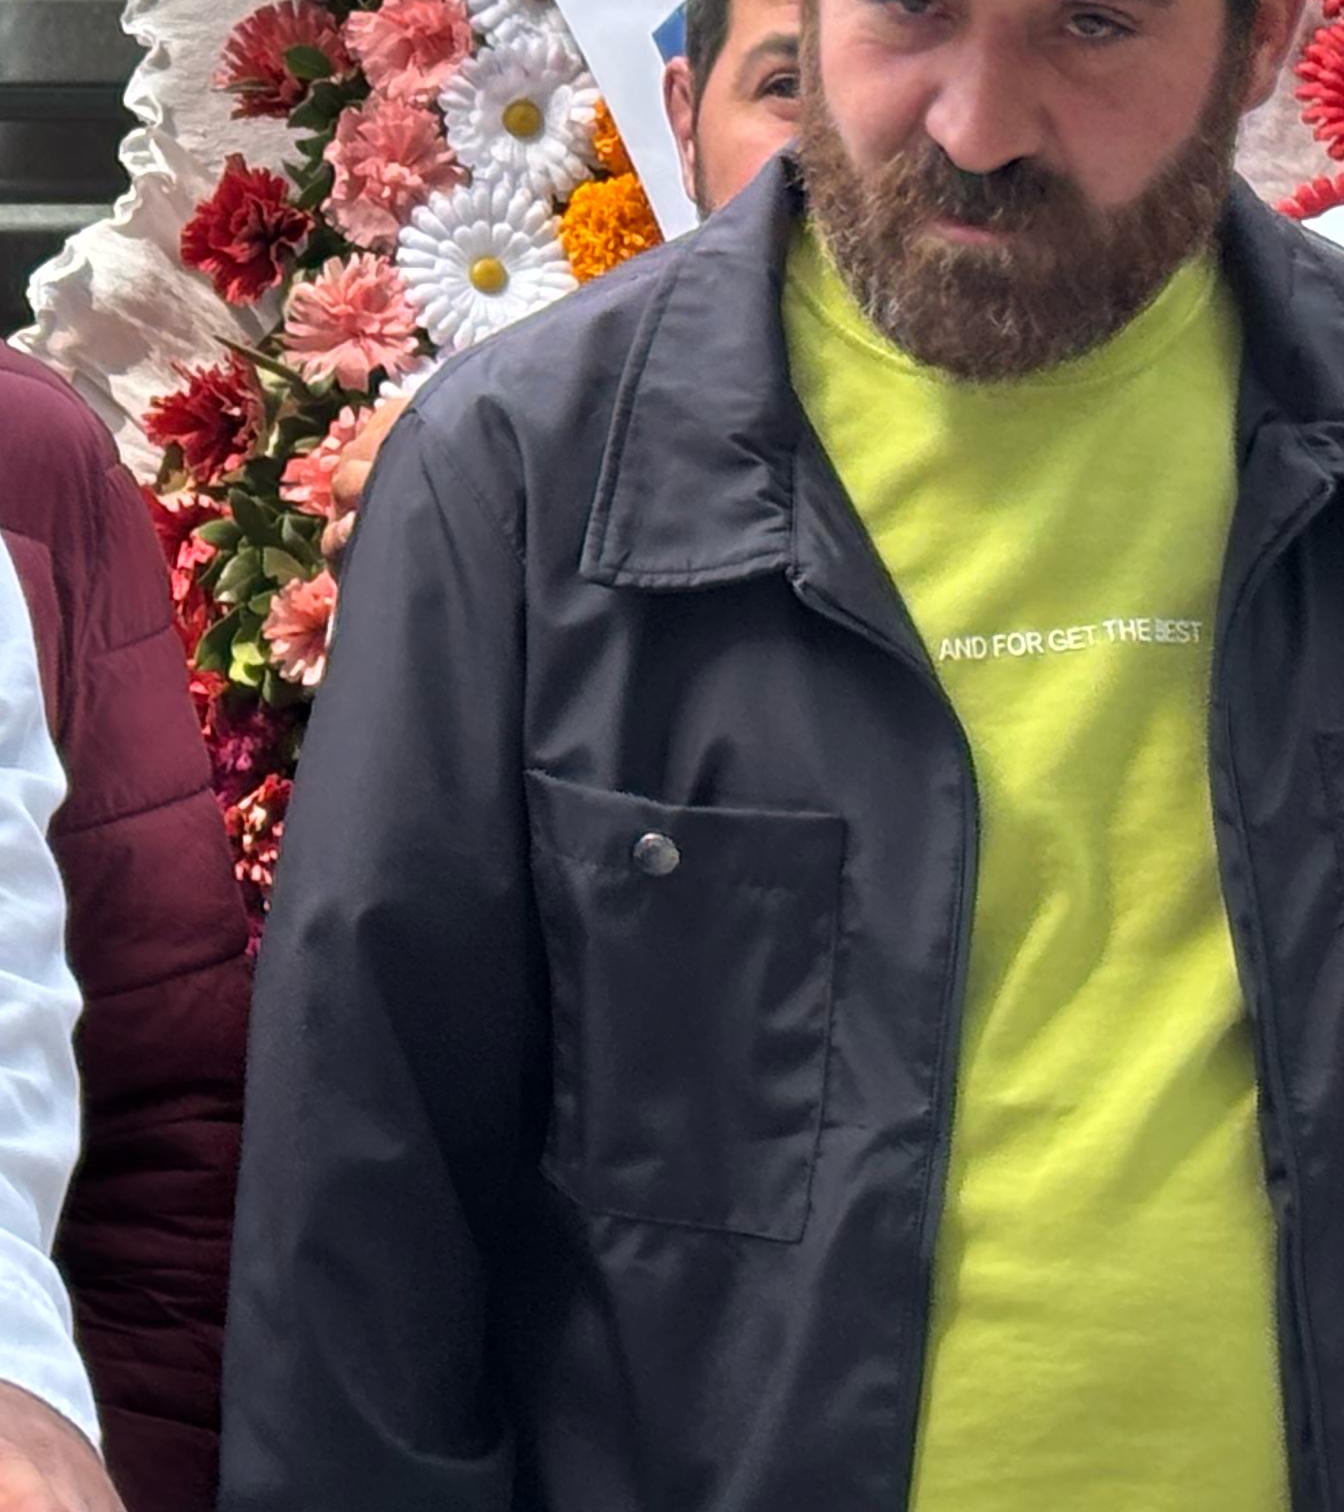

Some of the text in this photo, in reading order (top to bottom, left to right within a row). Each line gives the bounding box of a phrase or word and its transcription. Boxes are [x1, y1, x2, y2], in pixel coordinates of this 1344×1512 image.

[939, 618, 1202, 661] AND FOR GET THE BEST
